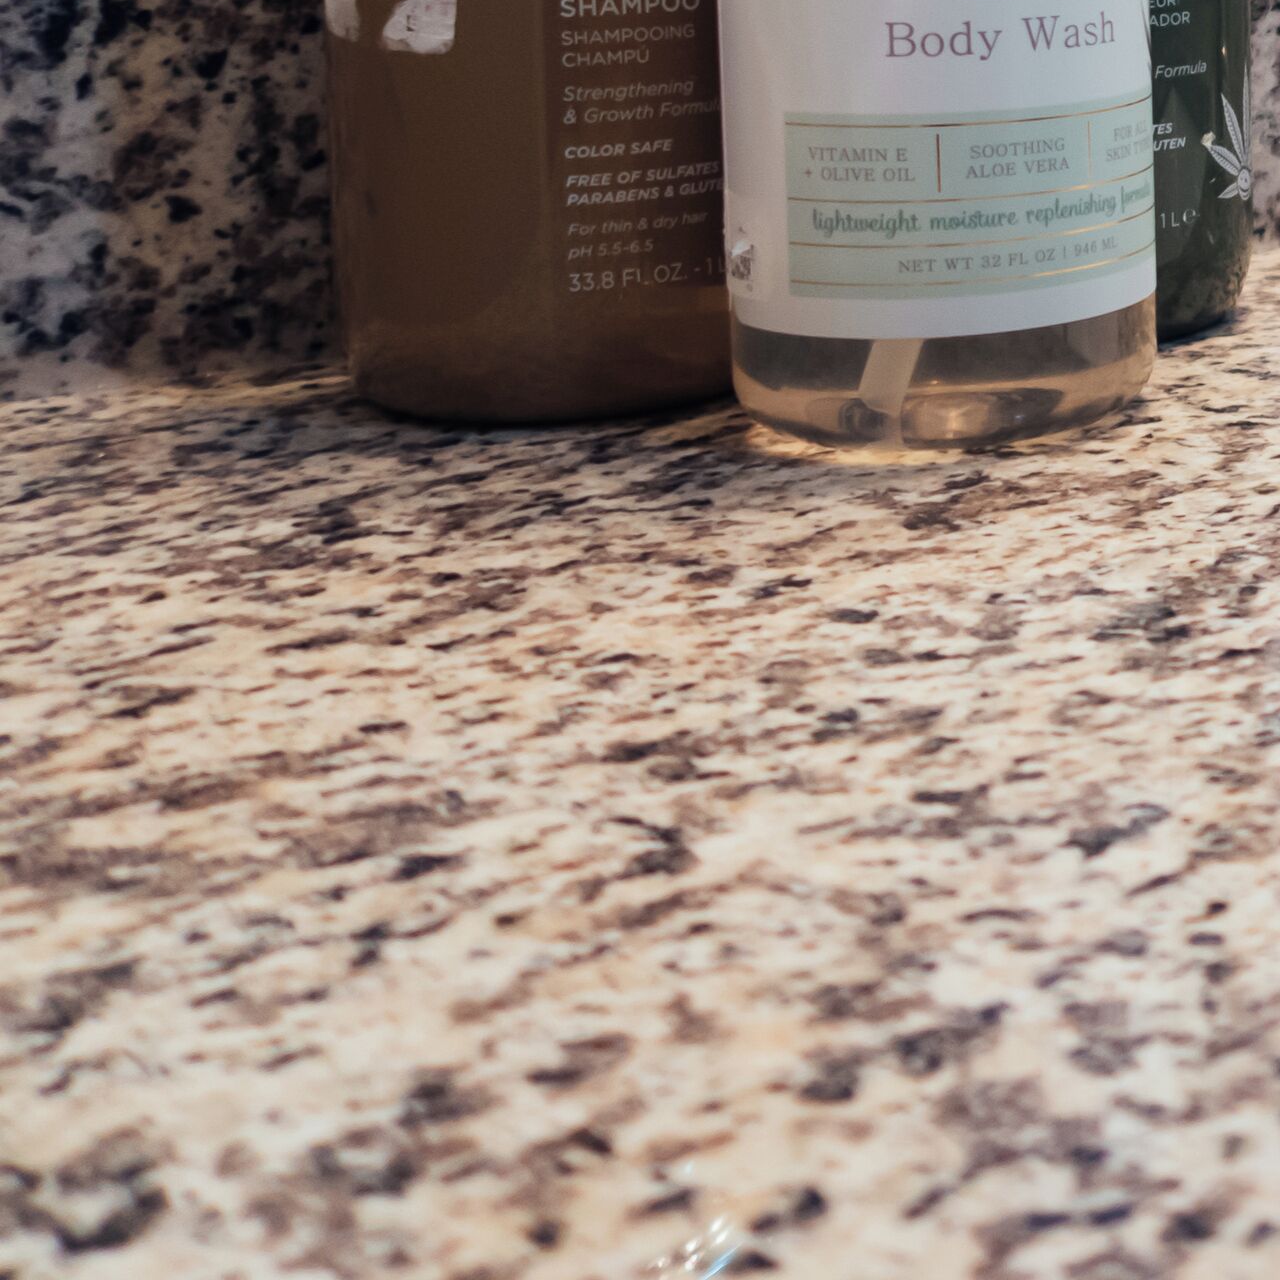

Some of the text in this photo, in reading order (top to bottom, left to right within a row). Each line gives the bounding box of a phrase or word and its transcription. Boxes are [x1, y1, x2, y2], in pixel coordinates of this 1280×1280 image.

[561, 24, 695, 46] SHAMPOOING
[885, 11, 1116, 61] Body Wash
[562, 45, 650, 68] CHAMPÚ
[1155, 59, 1207, 79] Formula
[563, 81, 695, 102] Strengthening
[563, 106, 577, 124] &
[584, 104, 654, 124] Growth
[564, 139, 674, 159] COLOR SAFE
[808, 146, 908, 163] VITAMIN E
[969, 137, 1066, 160] SOOTHING
[565, 161, 720, 188] FREE OF SULFATES
[821, 167, 875, 183] OLIVE
[882, 168, 915, 183] OIL
[966, 157, 1070, 180] ALOE VERA
[566, 186, 660, 206] PARABENS
[812, 207, 920, 239] lightweight
[930, 207, 1016, 231] moisture
[1025, 191, 1117, 227] replenishing
[568, 222, 596, 237] For
[602, 219, 633, 234] thin
[568, 244, 593, 261] pH
[898, 258, 936, 274] NET
[944, 256, 974, 272] WT
[981, 255, 1001, 270] 32
[1008, 251, 1029, 267] FL
[1035, 248, 1056, 264] OZ
[1074, 241, 1098, 257] 946
[1101, 235, 1119, 251] ML
[568, 270, 615, 292] 33.8
